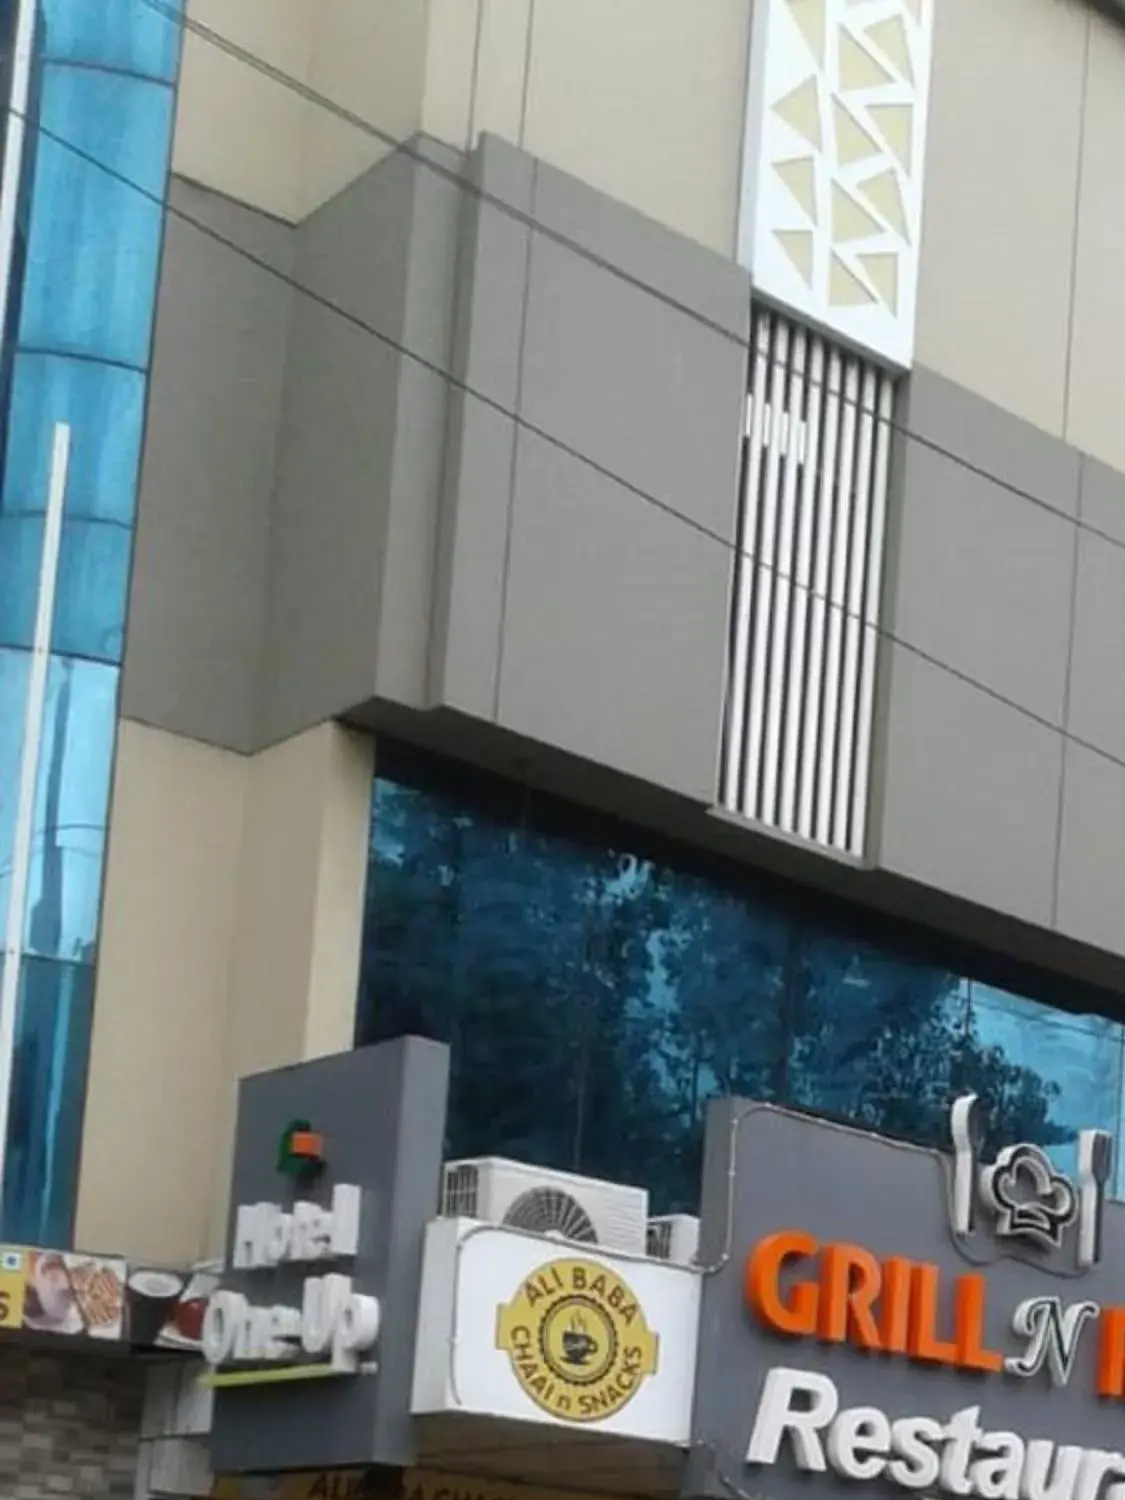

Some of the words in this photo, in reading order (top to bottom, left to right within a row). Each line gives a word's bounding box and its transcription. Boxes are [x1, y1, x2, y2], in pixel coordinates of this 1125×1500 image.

[202, 1289, 303, 1364] One
[302, 1272, 381, 1373] Up
[524, 1267, 564, 1308] ALI
[571, 1266, 639, 1326] BABA
[745, 1229, 1003, 1372] GRILL
[1003, 1295, 1099, 1387] N
[510, 1325, 556, 1401] CHAAI
[577, 1345, 643, 1415] SNACKS
